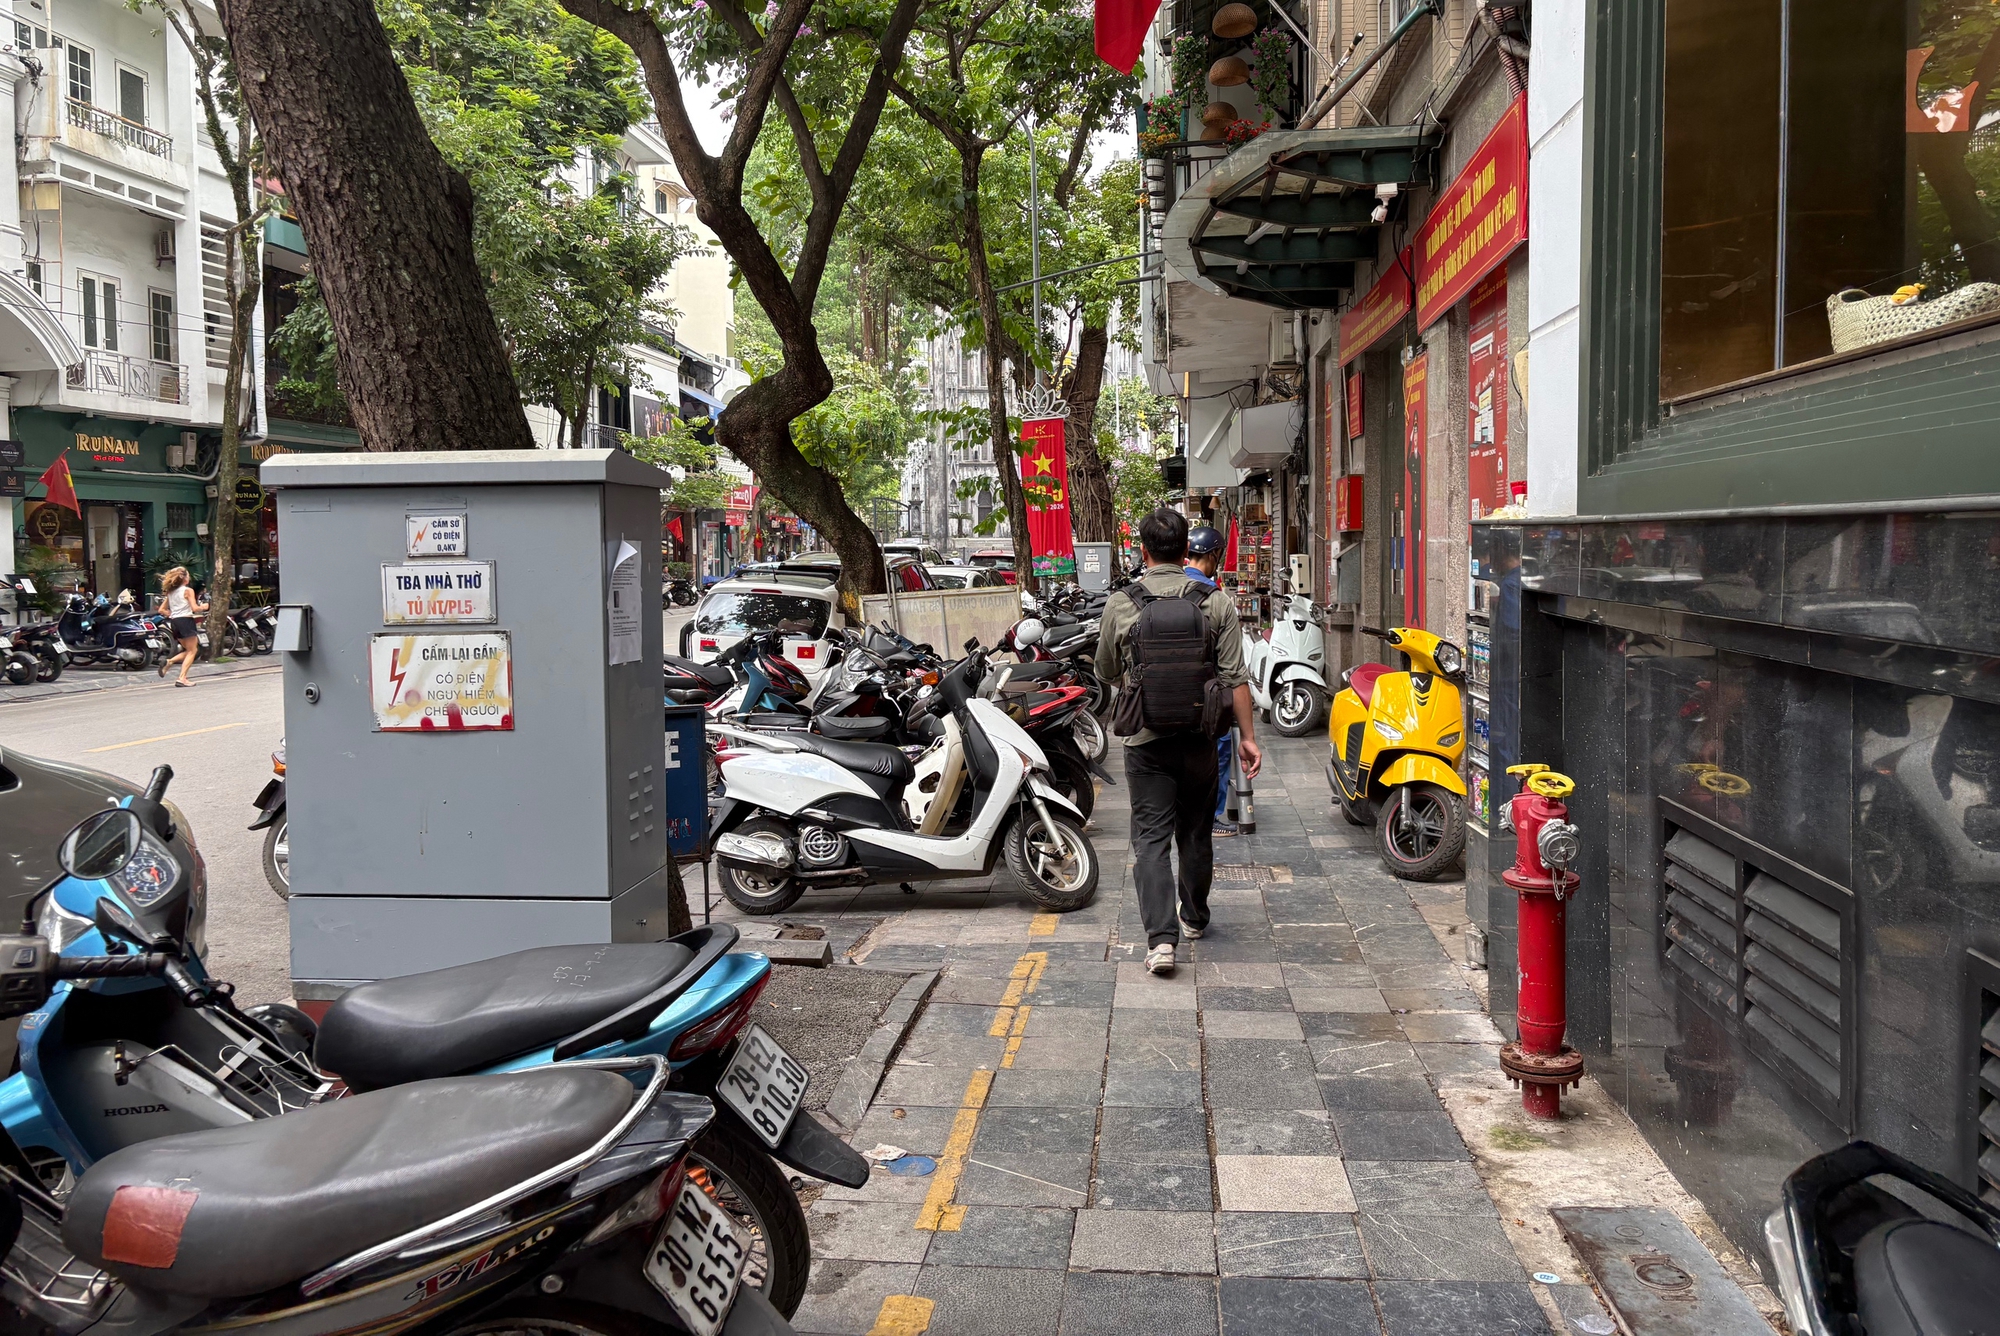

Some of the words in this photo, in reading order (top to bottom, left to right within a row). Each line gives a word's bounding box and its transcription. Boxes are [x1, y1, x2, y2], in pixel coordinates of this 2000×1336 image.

[432, 518, 448, 528] CẤM
[432, 531, 442, 540] CÓ
[444, 530, 460, 541] ĐIỆN
[396, 575, 421, 590] TBA
[425, 572, 453, 589] NHÀ
[456, 571, 482, 589] THỜ
[407, 596, 422, 615] TỦ
[427, 600, 472, 615] NT/PL5
[422, 644, 448, 660] CẤM
[452, 648, 469, 662] LẠI
[436, 672, 453, 684] CÓ
[457, 671, 485, 685] ĐIỆN
[428, 690, 460, 700] NGUY
[465, 685, 494, 700] HIỂM
[461, 704, 499, 715] NGƯỜI
[728, 1036, 777, 1104] 29-E2
[752, 1056, 804, 1137] 810.30
[104, 1104, 170, 1117] HONDA
[657, 1190, 712, 1286] 30-M2
[690, 1222, 742, 1323] 6555
